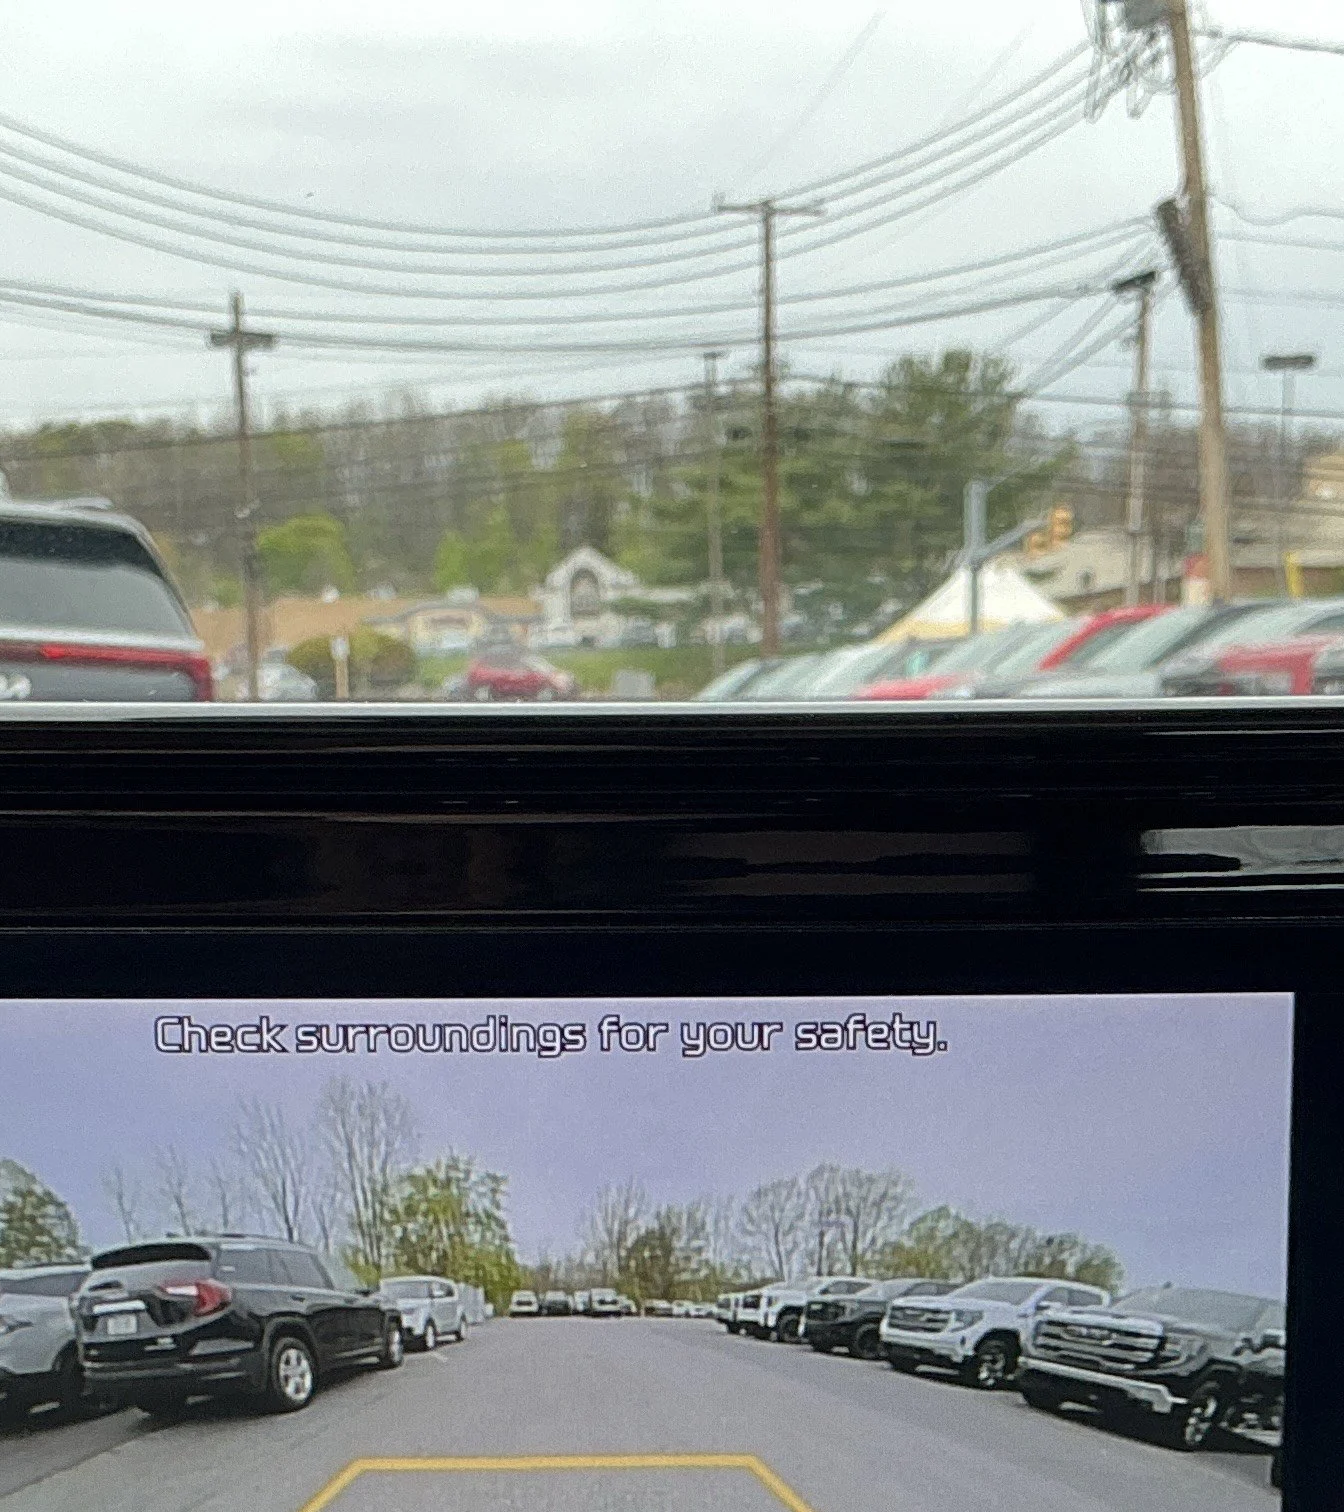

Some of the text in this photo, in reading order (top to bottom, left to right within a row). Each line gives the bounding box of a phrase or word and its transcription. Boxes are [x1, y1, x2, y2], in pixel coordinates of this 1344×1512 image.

[155, 1012, 948, 1058] Check surroundings for your safety.
